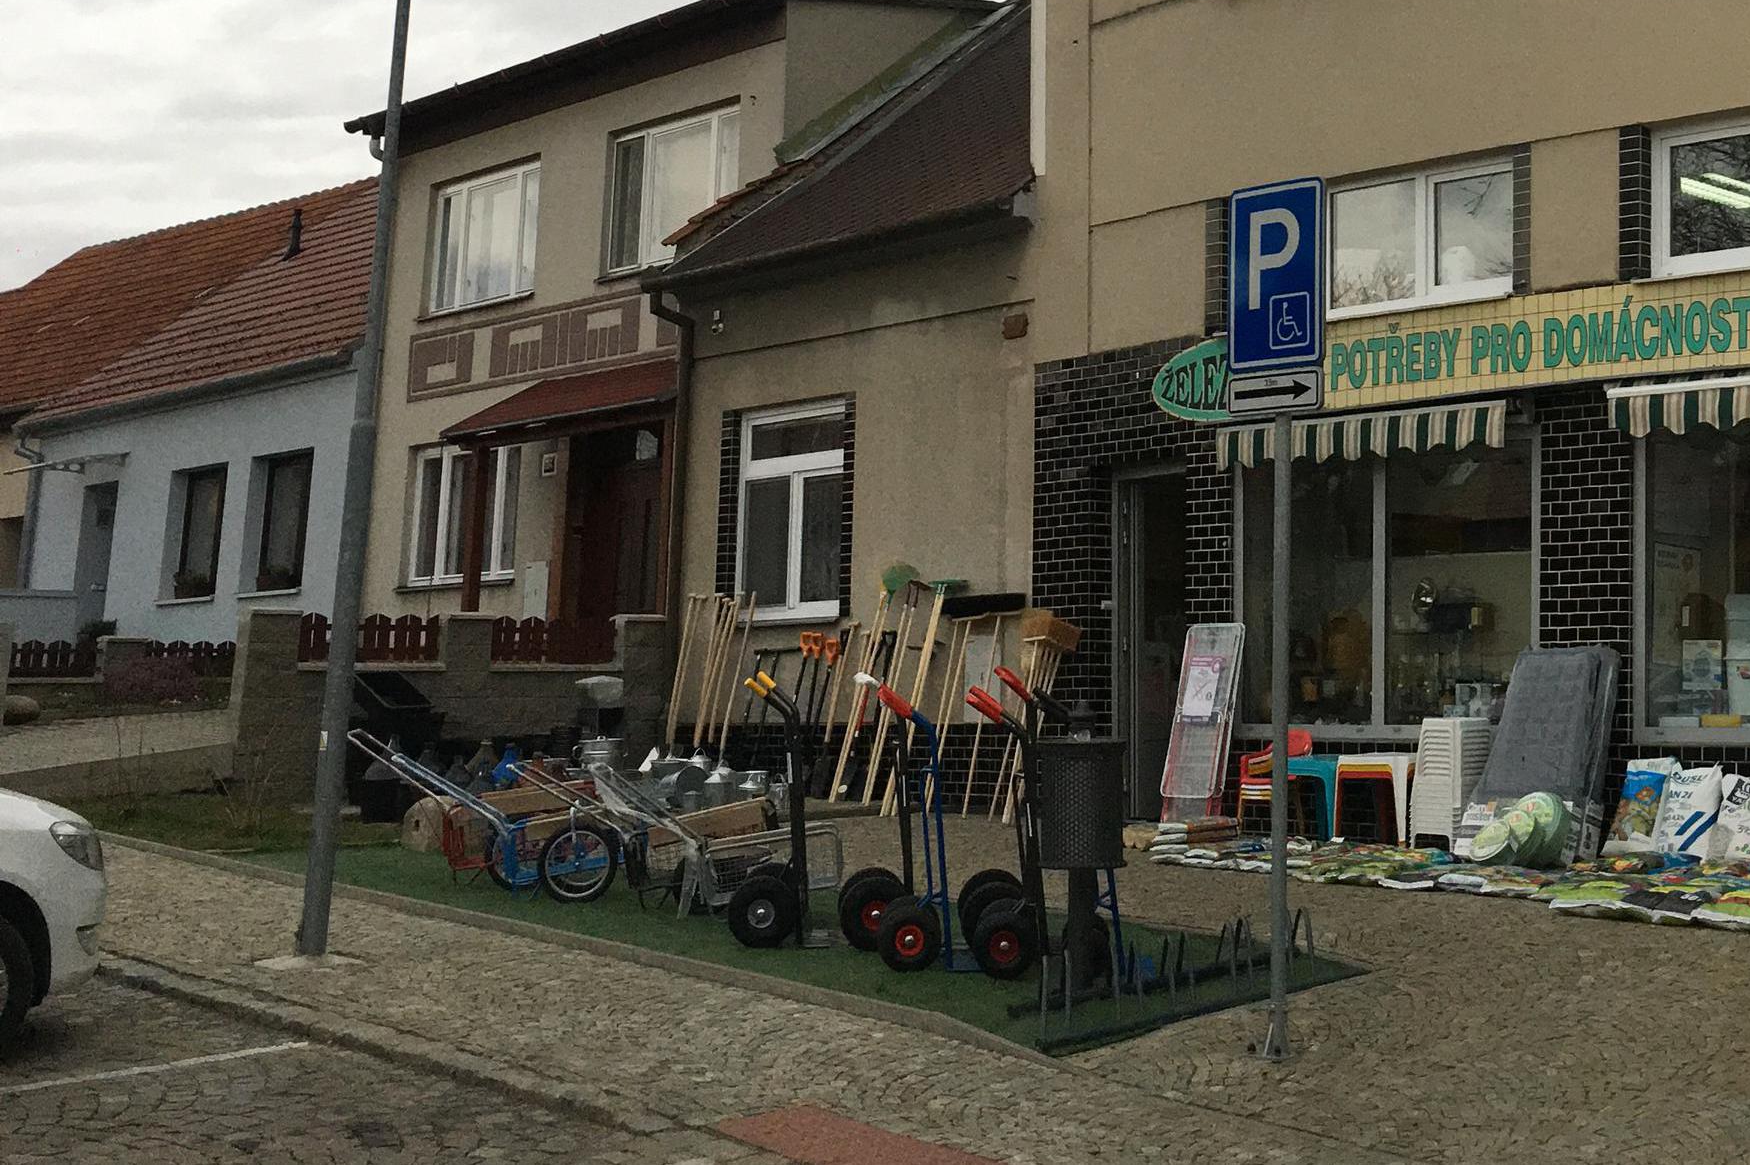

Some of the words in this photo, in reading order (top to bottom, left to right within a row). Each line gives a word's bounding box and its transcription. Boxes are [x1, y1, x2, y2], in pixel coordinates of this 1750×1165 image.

[1248, 207, 1299, 310] P
[1331, 323, 1462, 392] POTŘEBY
[1471, 329, 1531, 376] PRO
